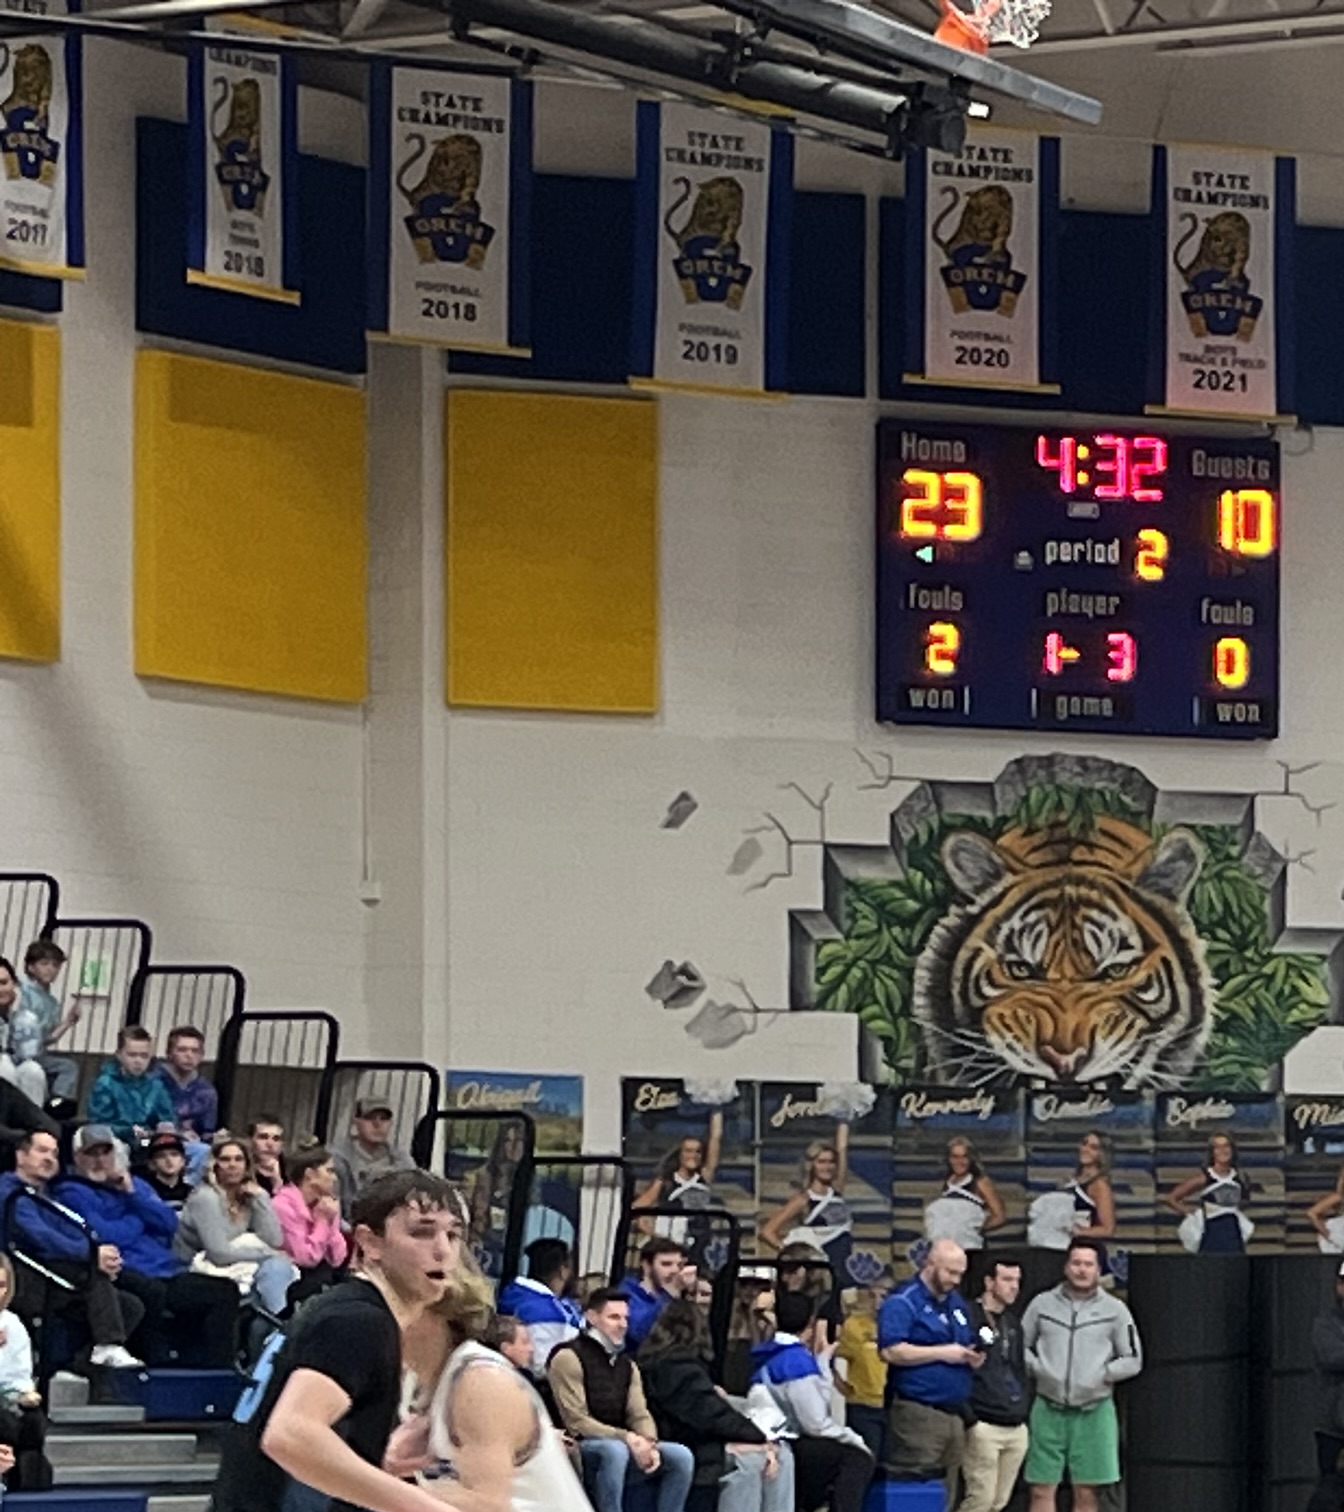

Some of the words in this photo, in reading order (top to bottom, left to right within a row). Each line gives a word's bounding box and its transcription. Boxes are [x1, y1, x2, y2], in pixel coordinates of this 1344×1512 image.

[420, 90, 483, 113] STATE
[397, 106, 505, 133] CHAMPIONS
[687, 131, 744, 152] STATE
[665, 147, 765, 172] CHAMPIONS
[955, 145, 1013, 164] STATE
[932, 161, 1034, 184] CHAMPIONS
[1192, 171, 1250, 190] STATE
[1173, 187, 1270, 211] CHAMPIONS
[415, 216, 485, 241] OREM
[680, 260, 743, 283] OREM
[950, 268, 1017, 290] OREM
[415, 280, 483, 298] FOOTBALL
[421, 299, 478, 322] 2018
[1190, 293, 1254, 314] OREM
[949, 330, 1012, 344] FOOTBALL
[682, 340, 738, 365] 2019
[955, 346, 1010, 368] 2020
[1192, 369, 1248, 392] 2021
[901, 431, 966, 463] Home
[1035, 434, 1168, 502] 4:32
[1191, 449, 1271, 481] Guests
[901, 469, 983, 541] 23
[1217, 489, 1275, 557] 10
[1044, 538, 1121, 566] period
[1135, 528, 1169, 581] 2
[908, 583, 964, 612] fouls
[1046, 588, 1121, 619] player
[1200, 598, 1254, 626] fouls
[926, 621, 961, 676] 2
[1105, 631, 1138, 682] 3
[1214, 636, 1250, 689] 0
[908, 687, 955, 709] won
[1055, 695, 1114, 721] game
[1217, 702, 1261, 723] won
